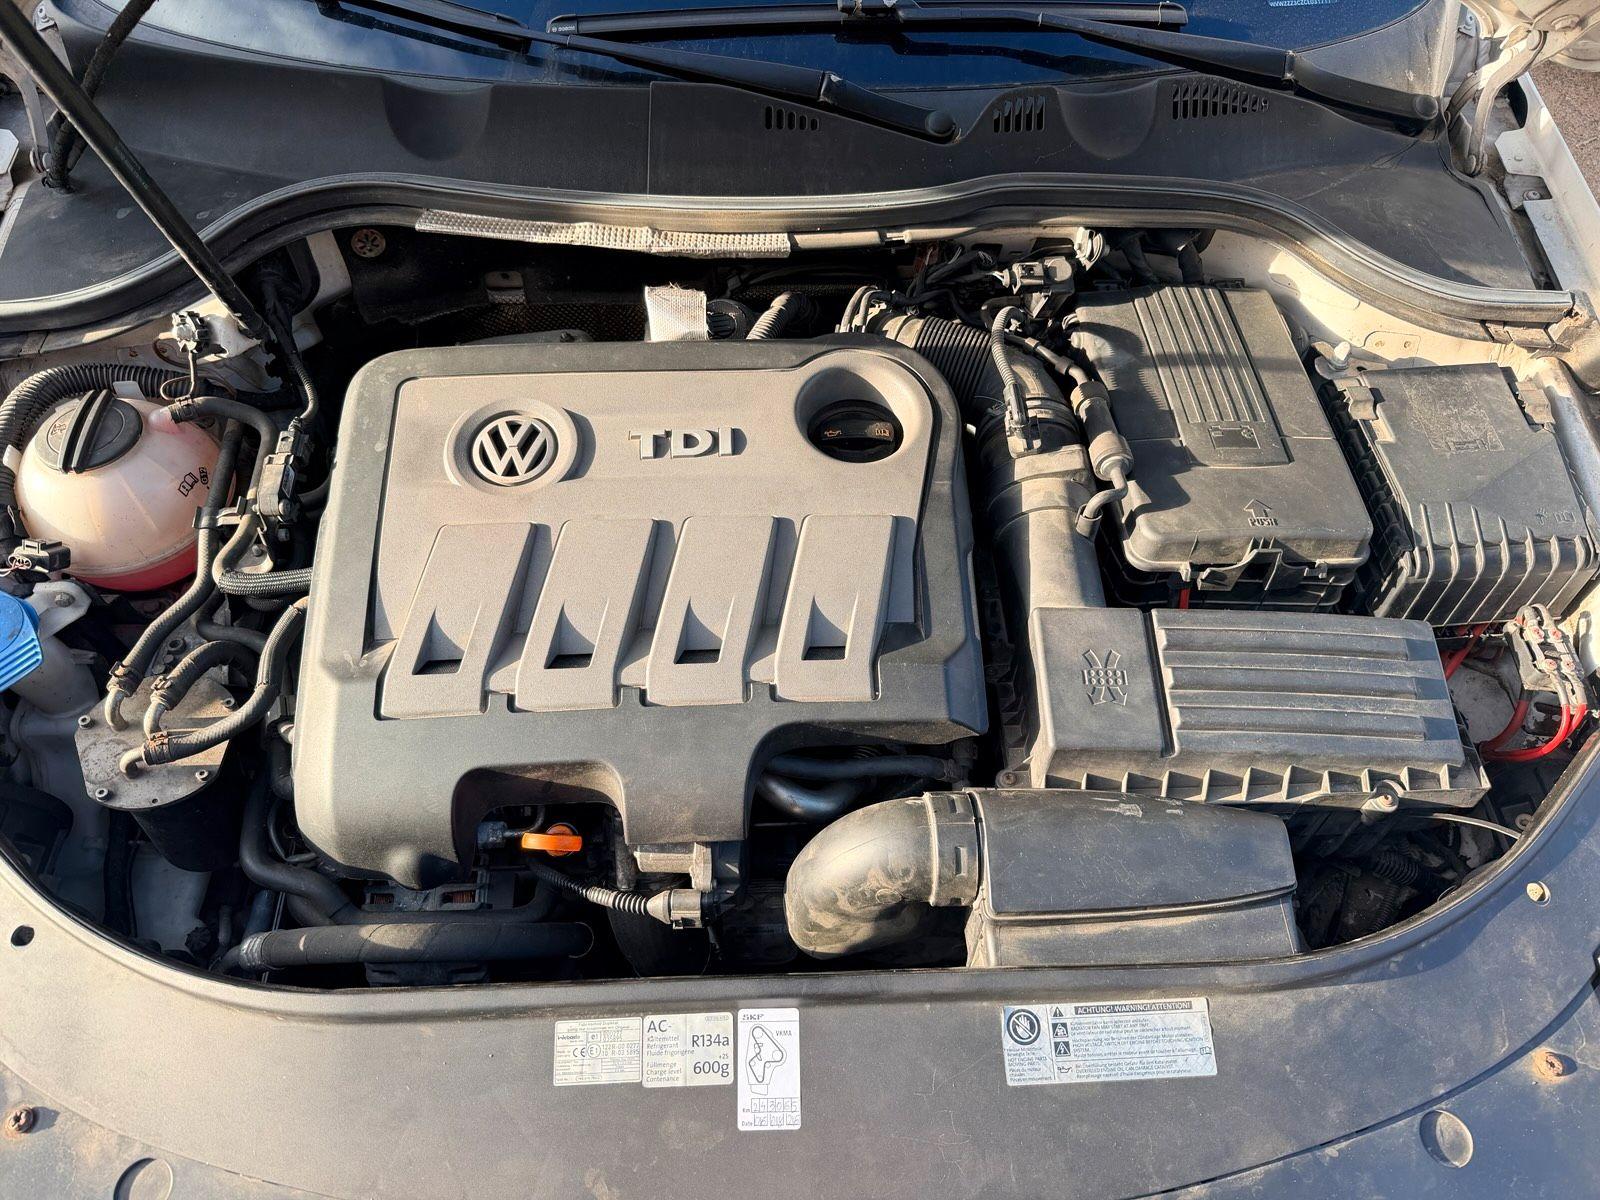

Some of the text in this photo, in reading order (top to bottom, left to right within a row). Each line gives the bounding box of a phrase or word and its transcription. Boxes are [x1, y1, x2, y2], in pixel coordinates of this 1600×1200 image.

[629, 427, 733, 460] TDI
[1248, 517, 1279, 527] PUSH
[1077, 1002, 1191, 1014] ACHTUNG! WARNING! ATTENTION!
[647, 1042, 679, 1050] Refrigerant
[692, 1034, 730, 1048] R134a
[647, 1062, 677, 1070] Füllmenge
[694, 1060, 730, 1078] 600g
[647, 1069, 667, 1077] Charge
